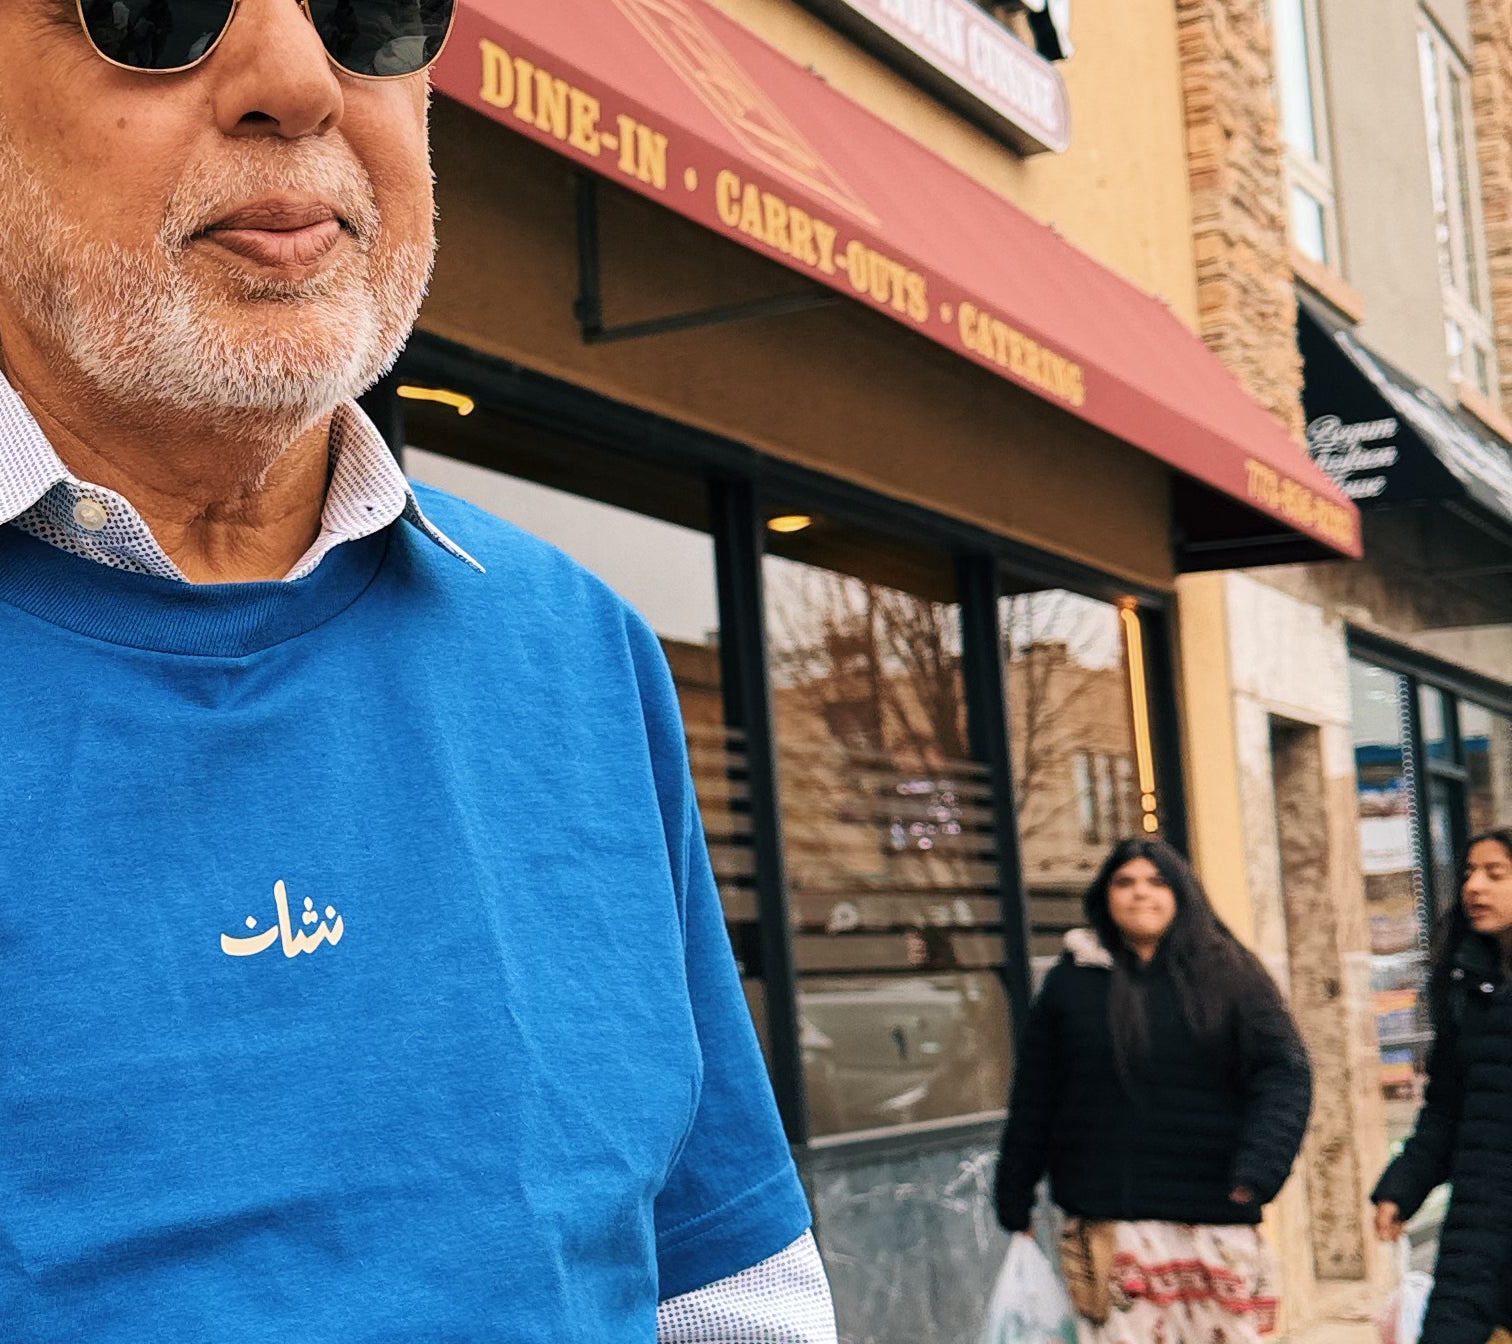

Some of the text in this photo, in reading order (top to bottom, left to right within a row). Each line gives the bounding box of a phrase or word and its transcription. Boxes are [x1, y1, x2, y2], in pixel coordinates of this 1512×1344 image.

[479, 40, 1084, 407] DINE-IN CARRY-OUTS CATERING
[220, 879, 345, 959] نشان
